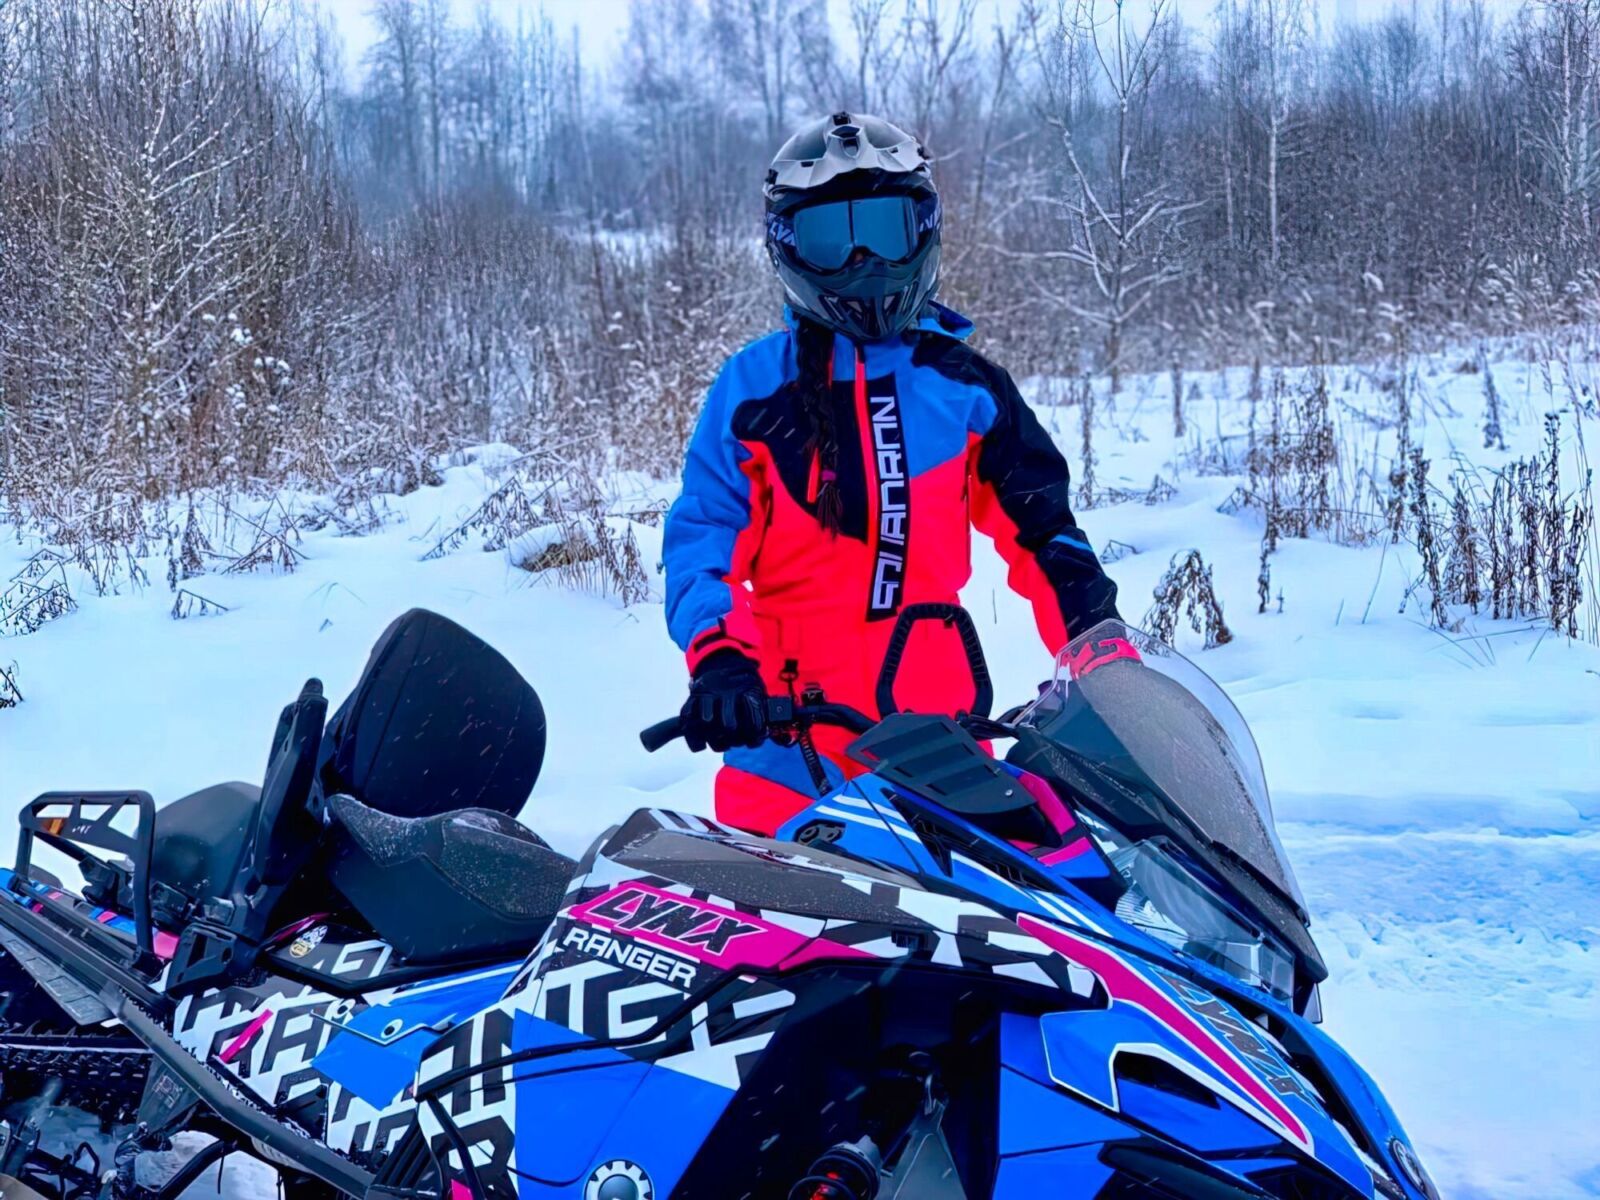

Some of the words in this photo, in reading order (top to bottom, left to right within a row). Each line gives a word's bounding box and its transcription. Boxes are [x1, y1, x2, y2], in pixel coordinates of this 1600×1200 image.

[584, 887, 769, 957] LYNX
[562, 926, 698, 989] RANGER
[1148, 965, 1327, 1119] LYNX
